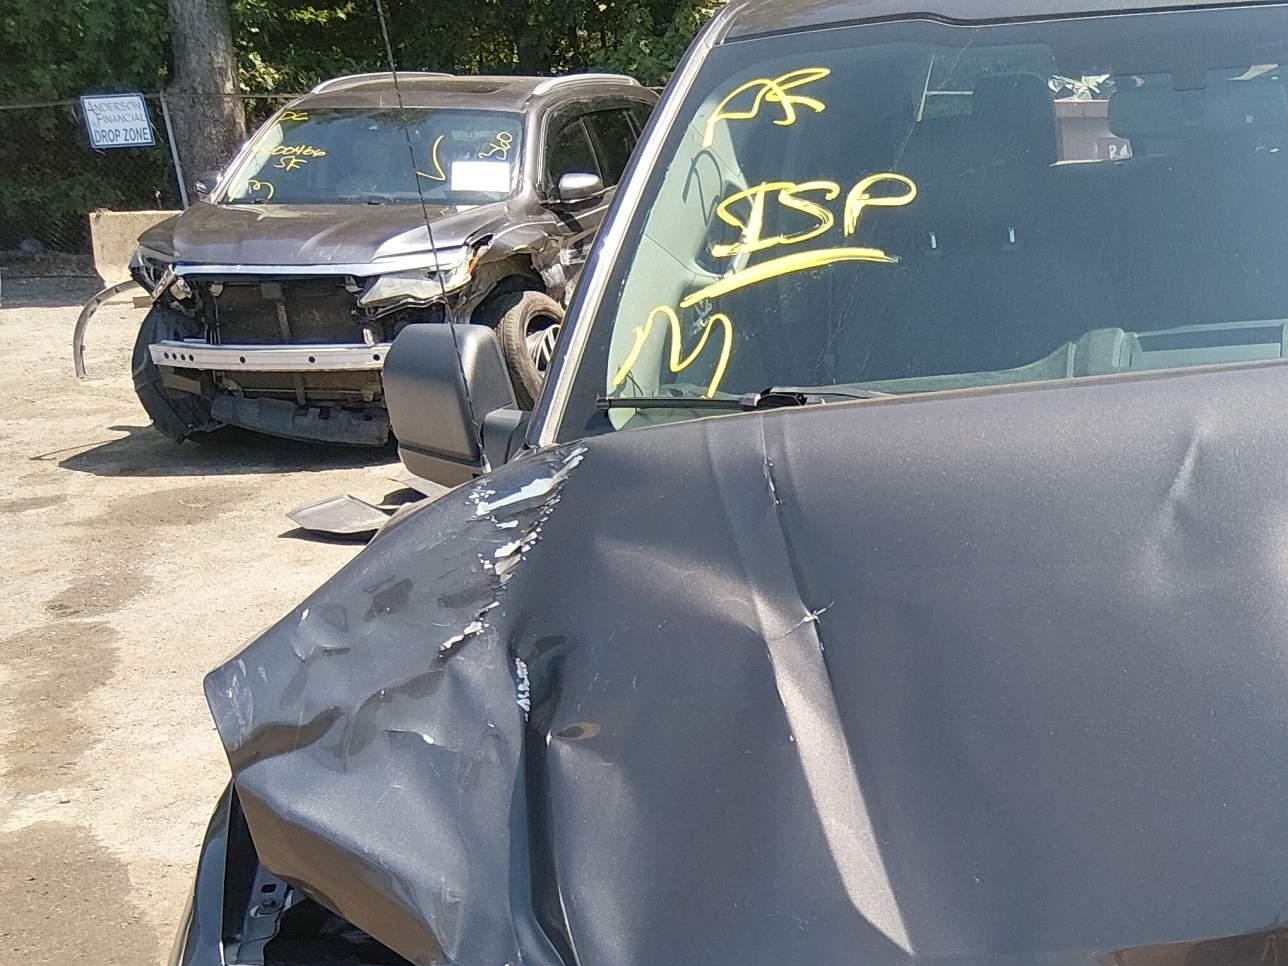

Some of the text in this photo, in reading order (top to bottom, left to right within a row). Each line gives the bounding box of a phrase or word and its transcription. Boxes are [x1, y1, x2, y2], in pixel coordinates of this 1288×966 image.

[88, 101, 142, 112] ANDERSON
[96, 111, 146, 126] FINANCIAL
[94, 127, 149, 143] DROP ZONE
